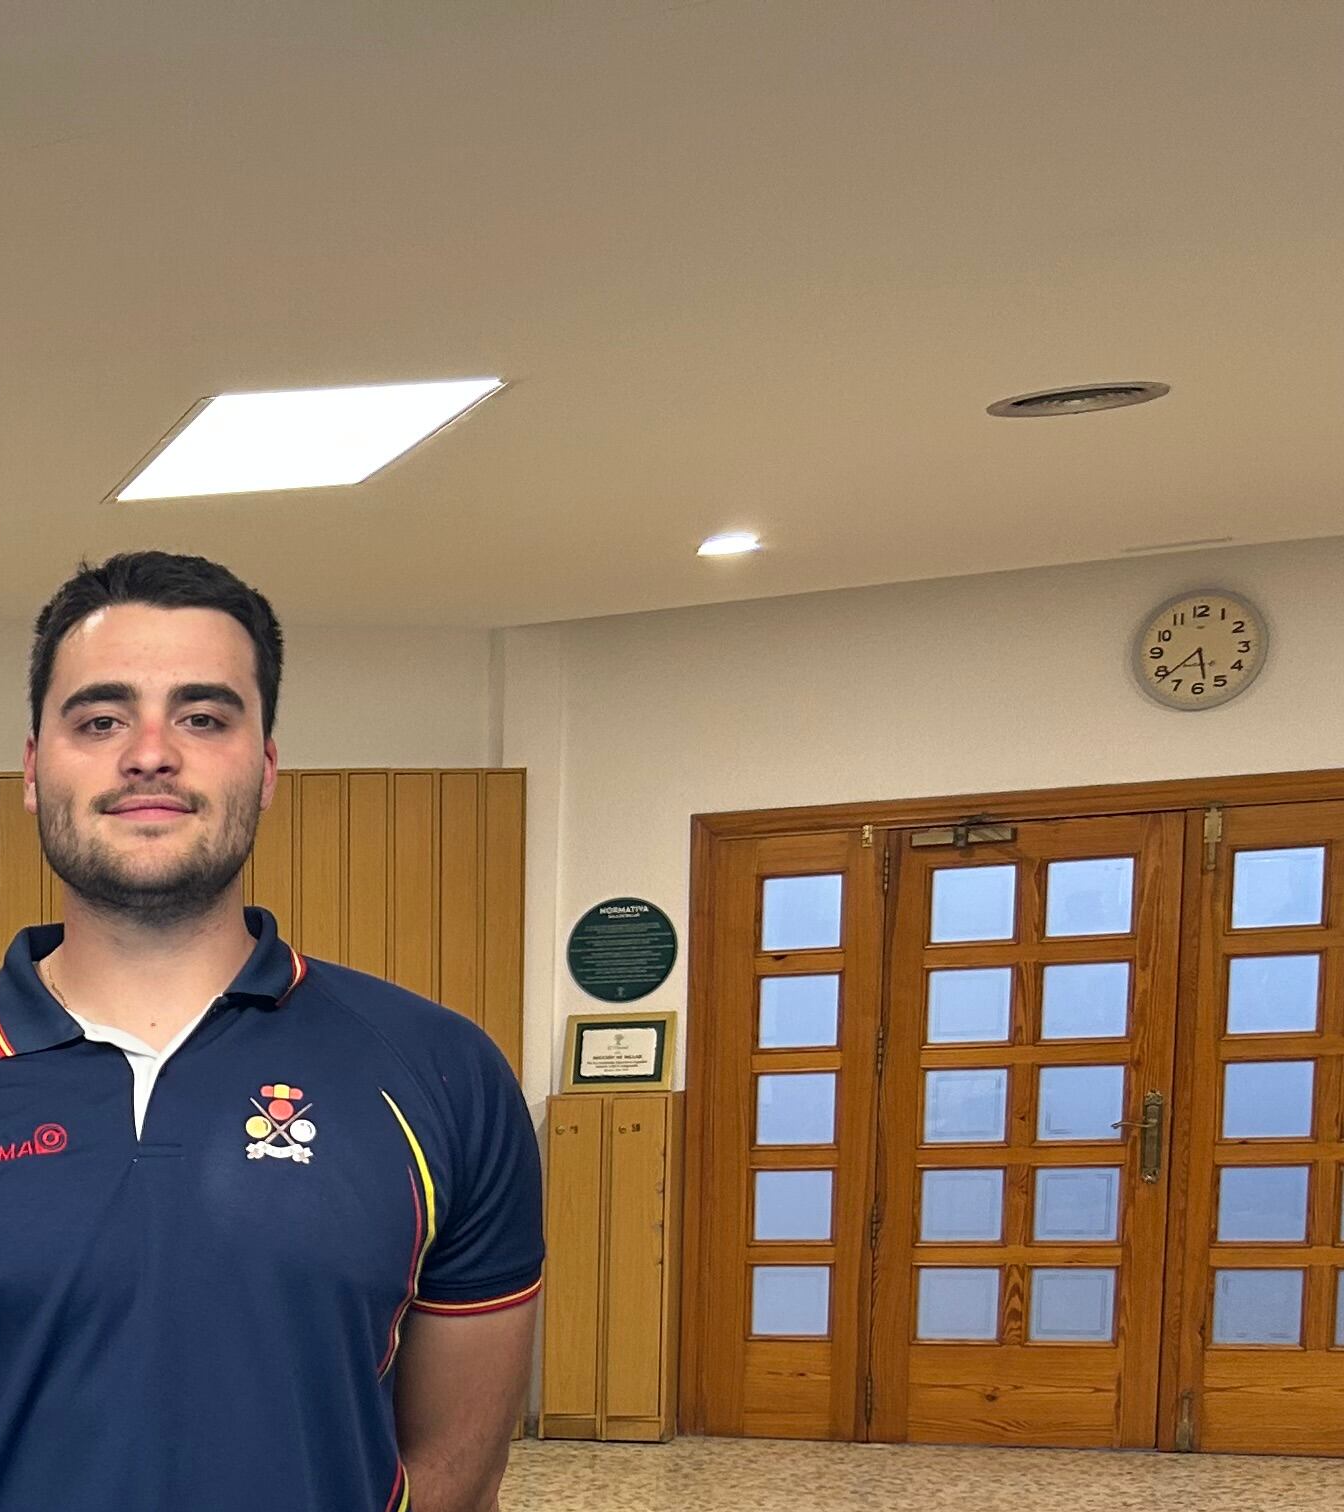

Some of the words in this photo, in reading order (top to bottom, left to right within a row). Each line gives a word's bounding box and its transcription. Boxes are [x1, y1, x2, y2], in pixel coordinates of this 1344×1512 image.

[1192, 605, 1210, 618] 12
[1220, 608, 1226, 620] 1
[1173, 613, 1184, 626] 11
[1232, 621, 1245, 633] 2
[1158, 630, 1172, 642] 10
[1237, 640, 1250, 653] 3
[1149, 647, 1163, 659] 9
[1230, 659, 1243, 671] 4
[1154, 666, 1169, 677] 8
[1171, 679, 1183, 691] 7
[1213, 675, 1227, 687] 5
[1191, 683, 1204, 694] 6
[600, 905, 649, 914] NORMATIVA
